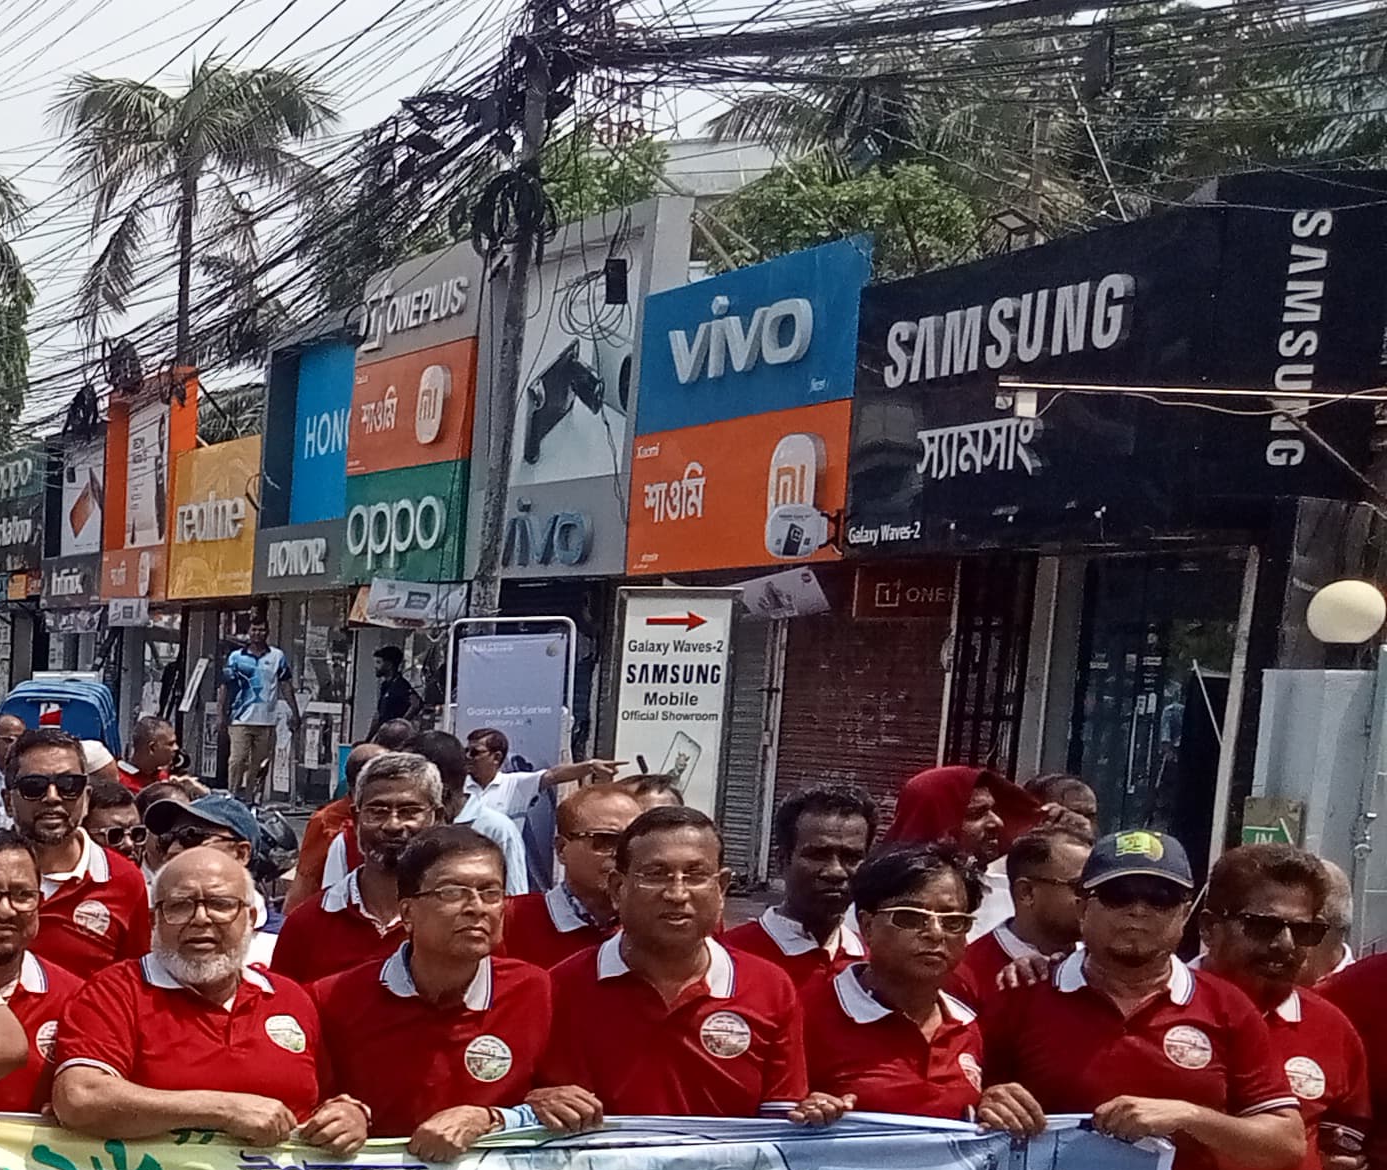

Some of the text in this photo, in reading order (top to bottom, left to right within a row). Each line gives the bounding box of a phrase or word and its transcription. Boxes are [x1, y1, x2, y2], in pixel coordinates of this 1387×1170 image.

[387, 277, 469, 334] ONEPLUS
[883, 273, 1136, 389] SAMSUNG
[668, 295, 814, 384] vivo
[1266, 210, 1333, 466] SAMSUNG
[304, 407, 351, 460] HON
[916, 417, 1042, 480] স্যামসাং
[175, 490, 245, 545] realme
[643, 461, 706, 523] শাওমি
[268, 539, 325, 577] HONOR
[346, 495, 446, 570] oppo
[848, 525, 878, 546] Galaxy
[626, 664, 721, 684] SAMSUNG
[628, 640, 724, 656] Galaxy Waves-2
[621, 710, 719, 721] Official Showroom
[644, 692, 698, 706] Mobile
